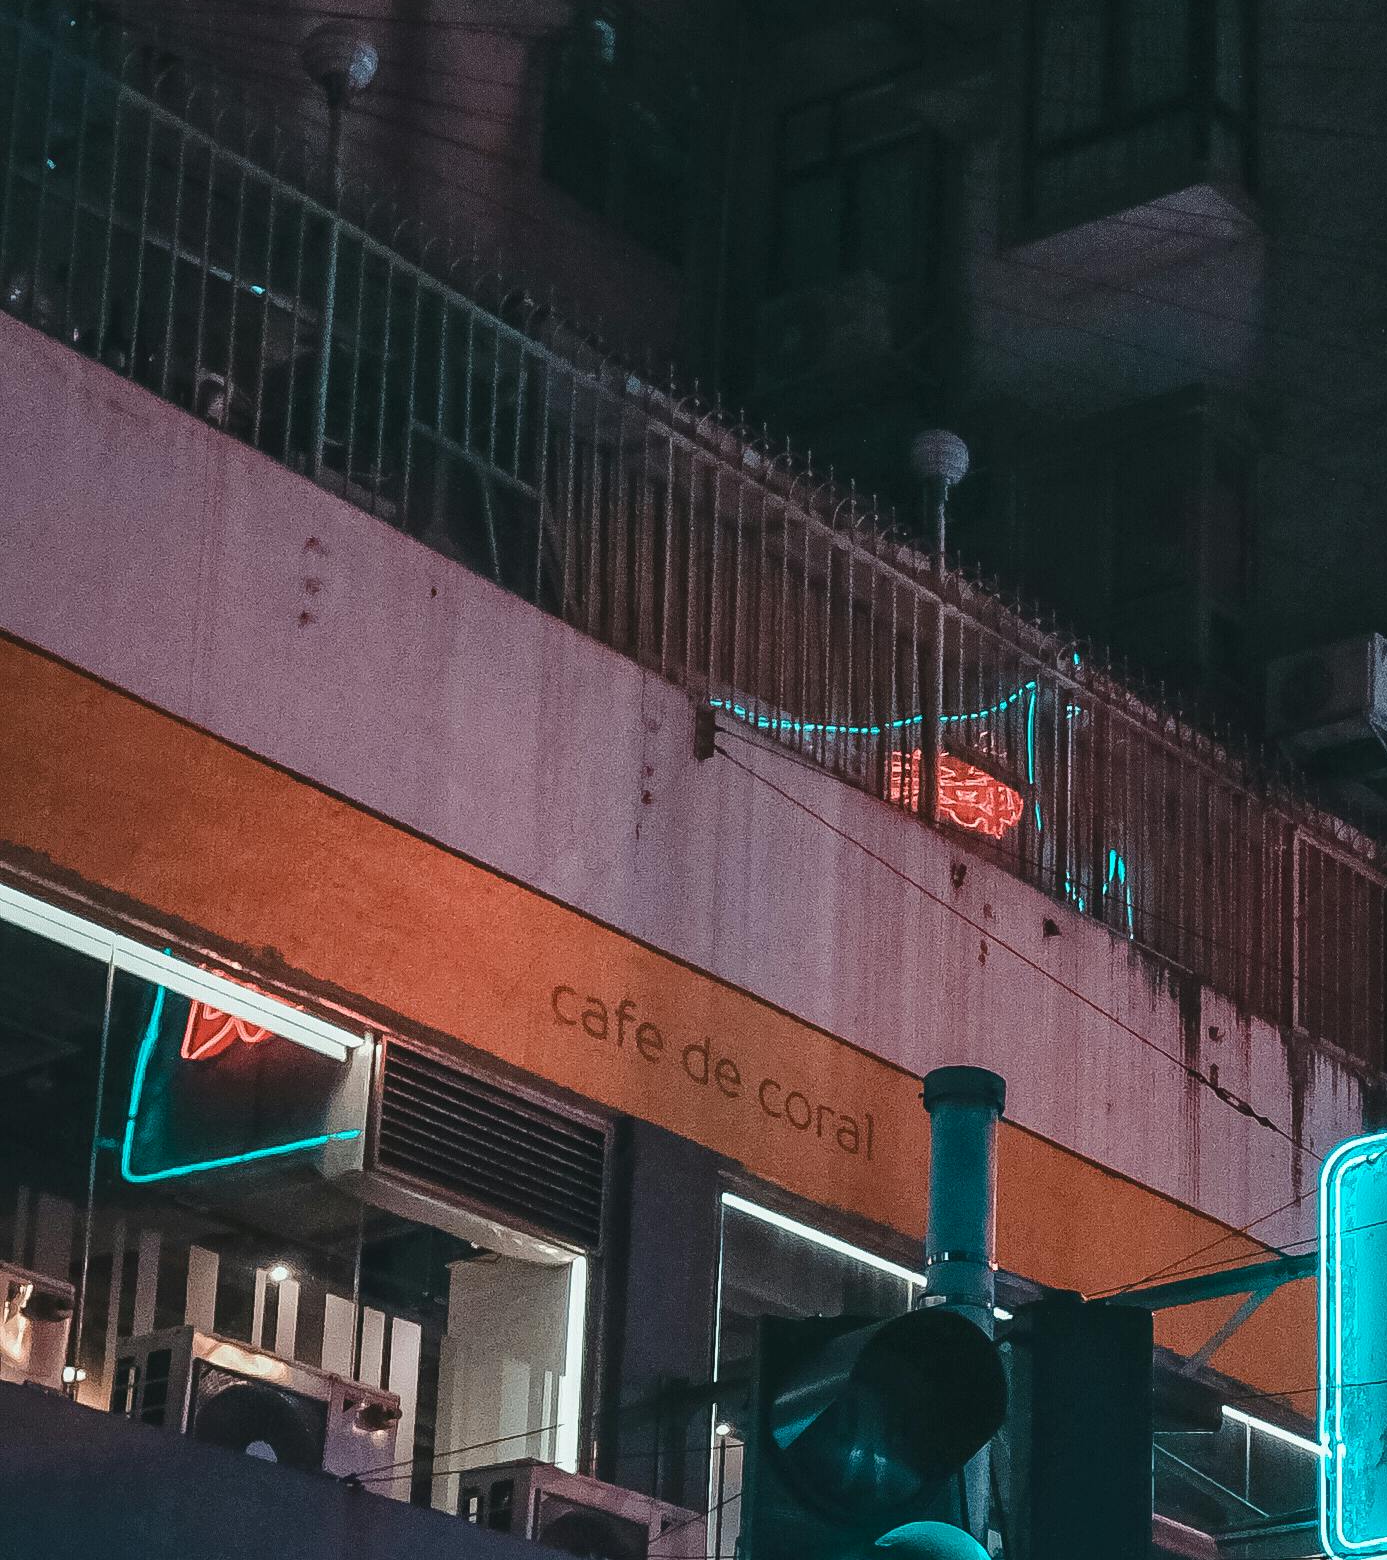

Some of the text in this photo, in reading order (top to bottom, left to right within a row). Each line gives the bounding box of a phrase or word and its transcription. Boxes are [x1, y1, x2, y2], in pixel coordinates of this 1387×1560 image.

[550, 984, 876, 1161] cafe de coral
